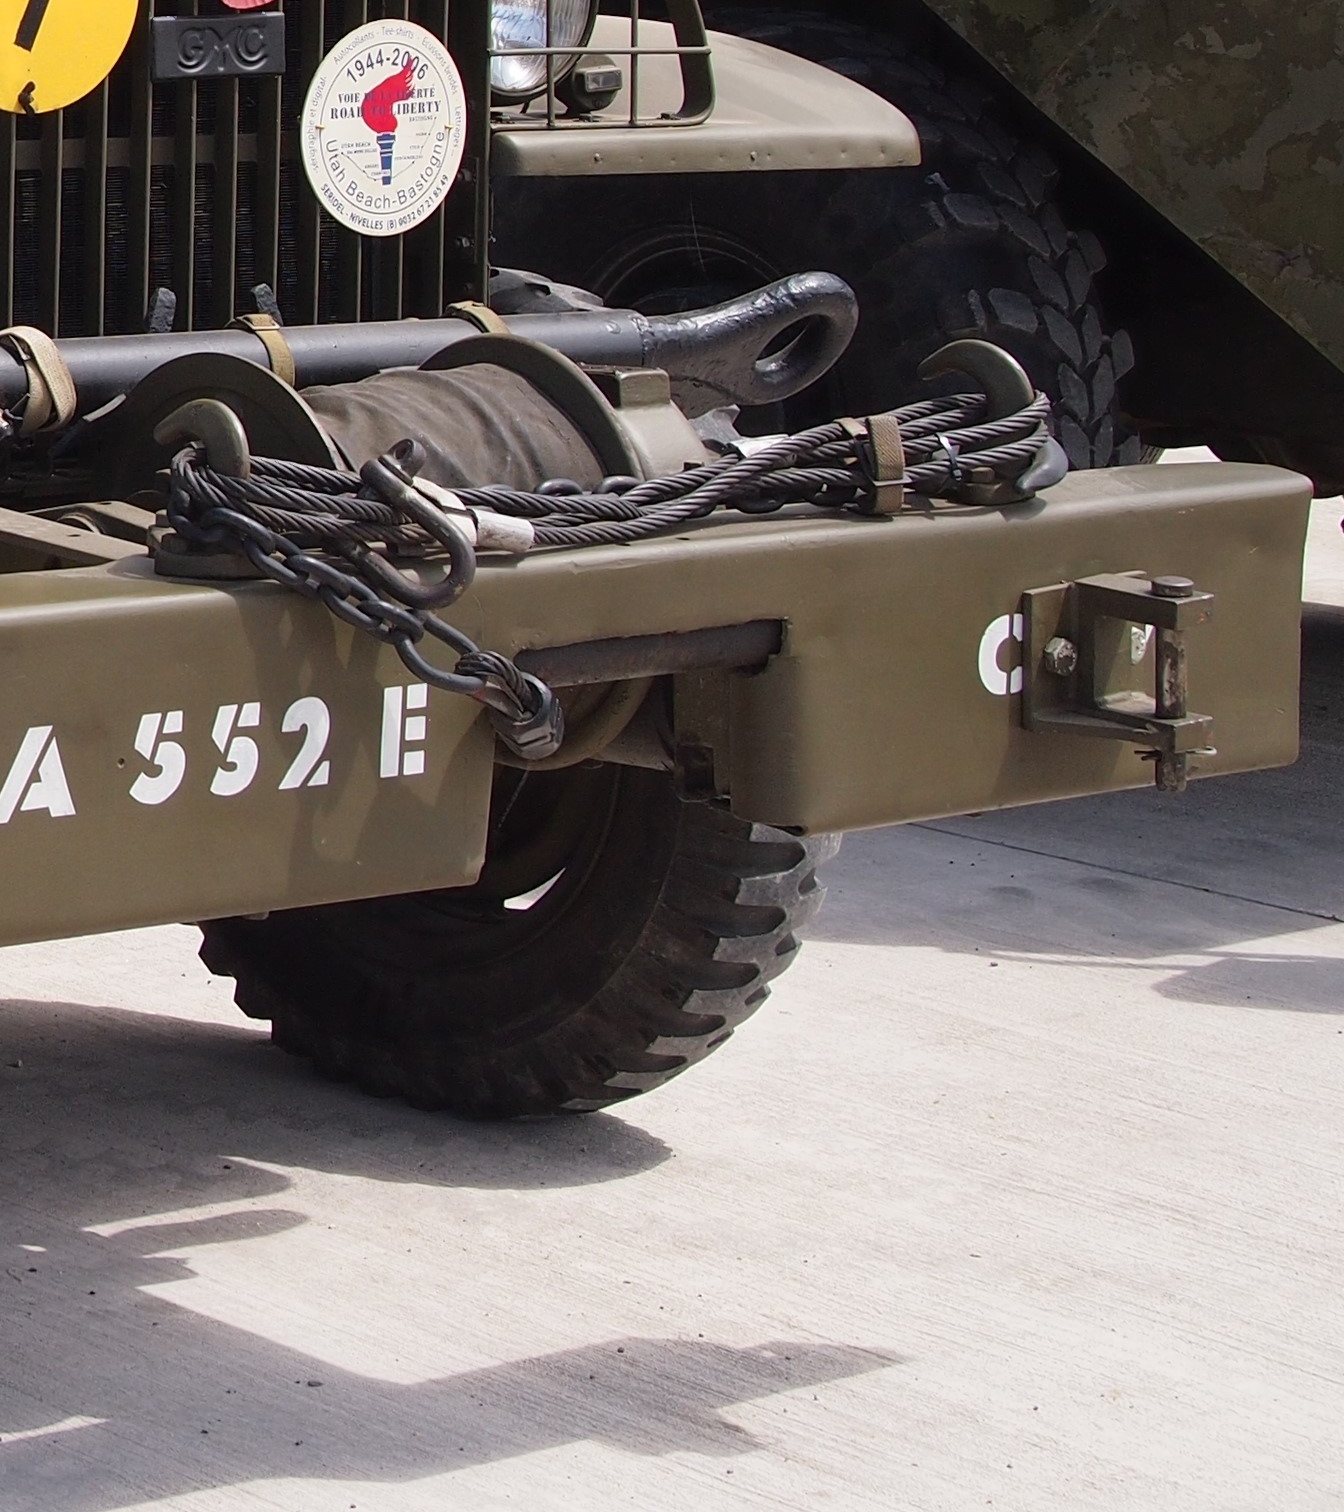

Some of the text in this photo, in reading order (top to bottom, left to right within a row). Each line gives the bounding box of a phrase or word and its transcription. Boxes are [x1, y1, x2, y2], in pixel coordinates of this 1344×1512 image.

[177, 24, 269, 73] GMC
[346, 48, 429, 84] 1944-2006
[338, 92, 361, 104] VOIE
[325, 139, 346, 184] Utah
[320, 183, 345, 216] SERIDEL
[349, 212, 384, 231] NIVELLES
[129, 695, 330, 805] 552
[379, 683, 428, 778] E
